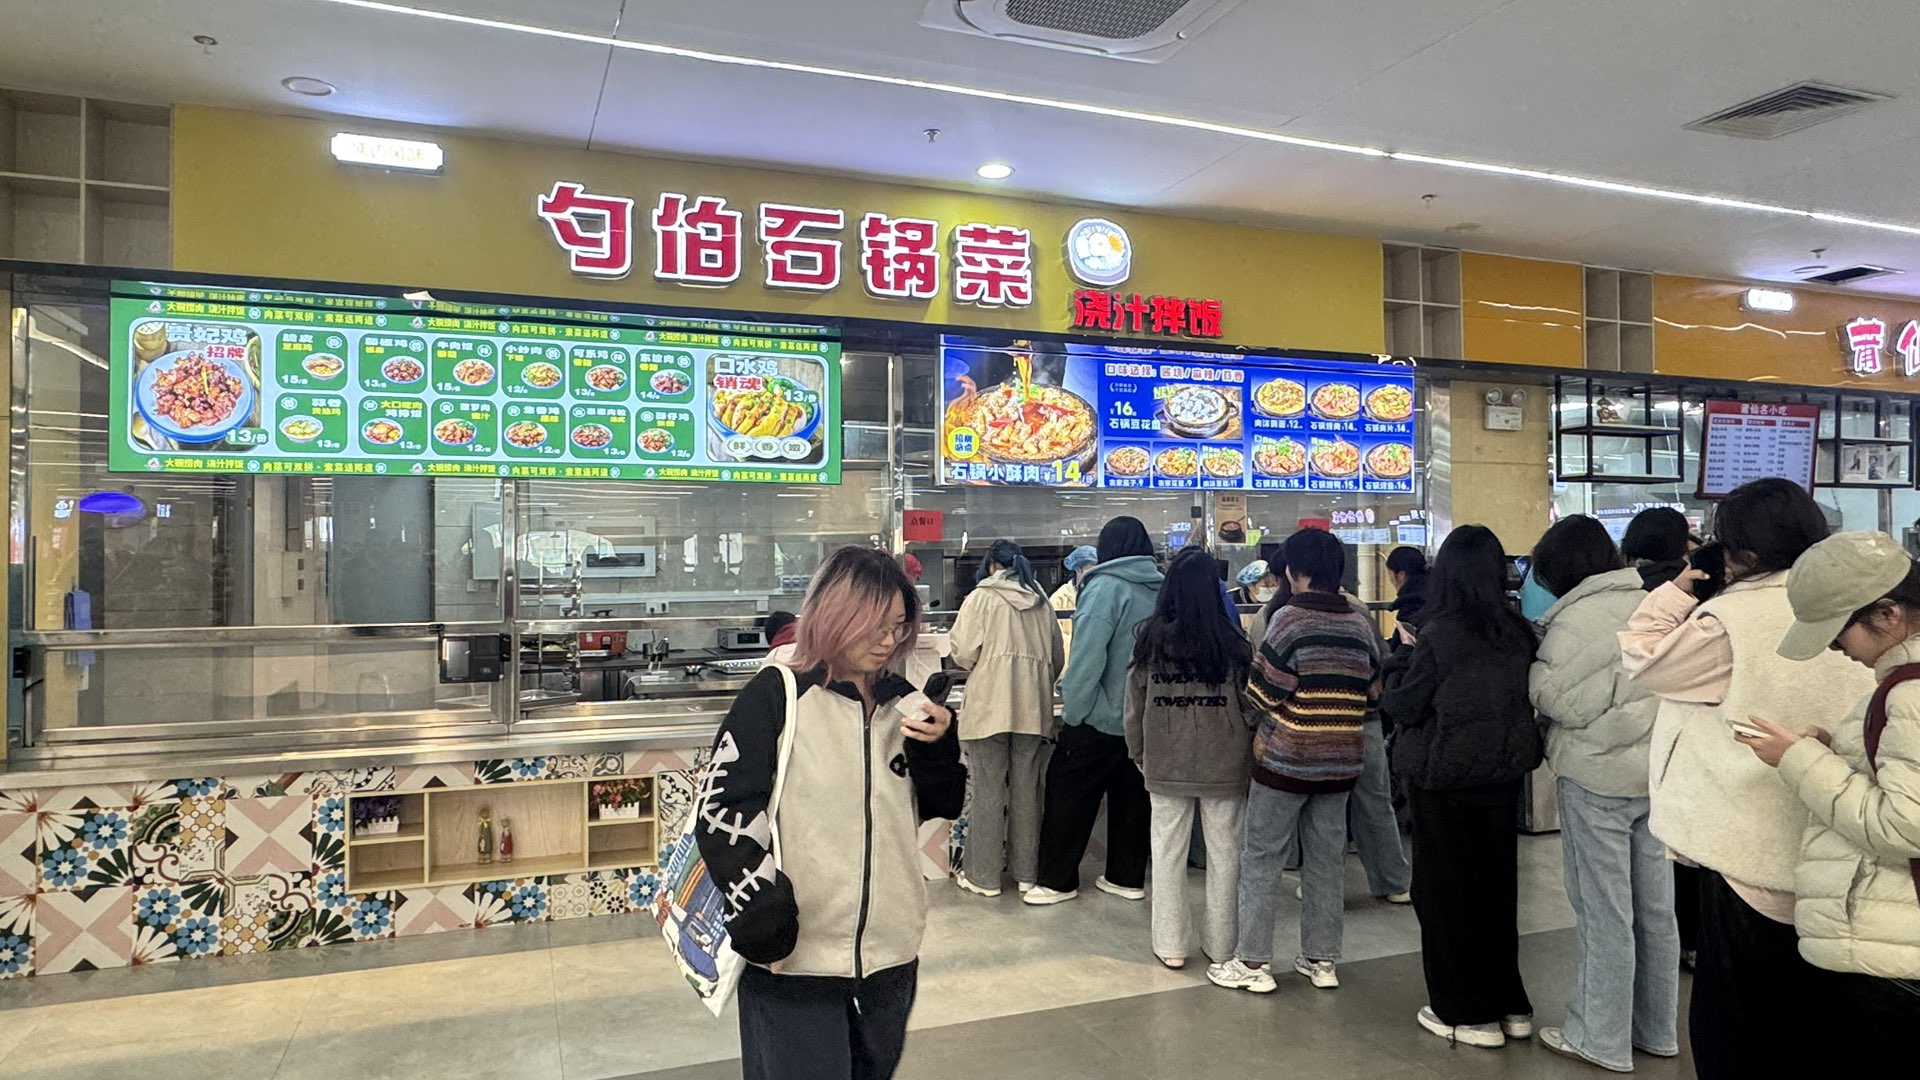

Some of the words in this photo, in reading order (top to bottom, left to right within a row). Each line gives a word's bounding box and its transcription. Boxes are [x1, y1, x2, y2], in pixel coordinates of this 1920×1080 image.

[1074, 290, 1223, 337] 浇汁拌饭
[207, 346, 245, 359] 招牌
[714, 357, 778, 376] 口水鸡
[281, 374, 309, 385] 15/
[364, 379, 387, 388] 13/
[436, 382, 461, 392] 15/
[506, 385, 529, 394] 12/
[1154, 385, 1176, 399] NEW
[574, 388, 596, 397] 13/
[640, 391, 661, 400] 14/
[783, 389, 818, 404] 13/份
[1110, 400, 1138, 417] ¥16
[1109, 418, 1161, 430] 石锅豆花鱼
[227, 429, 268, 443] 13/份
[316, 439, 341, 448] 13/
[399, 441, 422, 450] 13/
[466, 444, 492, 453] 12/
[537, 446, 561, 455] 12/
[603, 447, 626, 456] 13/
[671, 449, 691, 458] 12/
[951, 463, 1039, 482] 石锅小酥肉
[1151, 673, 1227, 684] TWES
